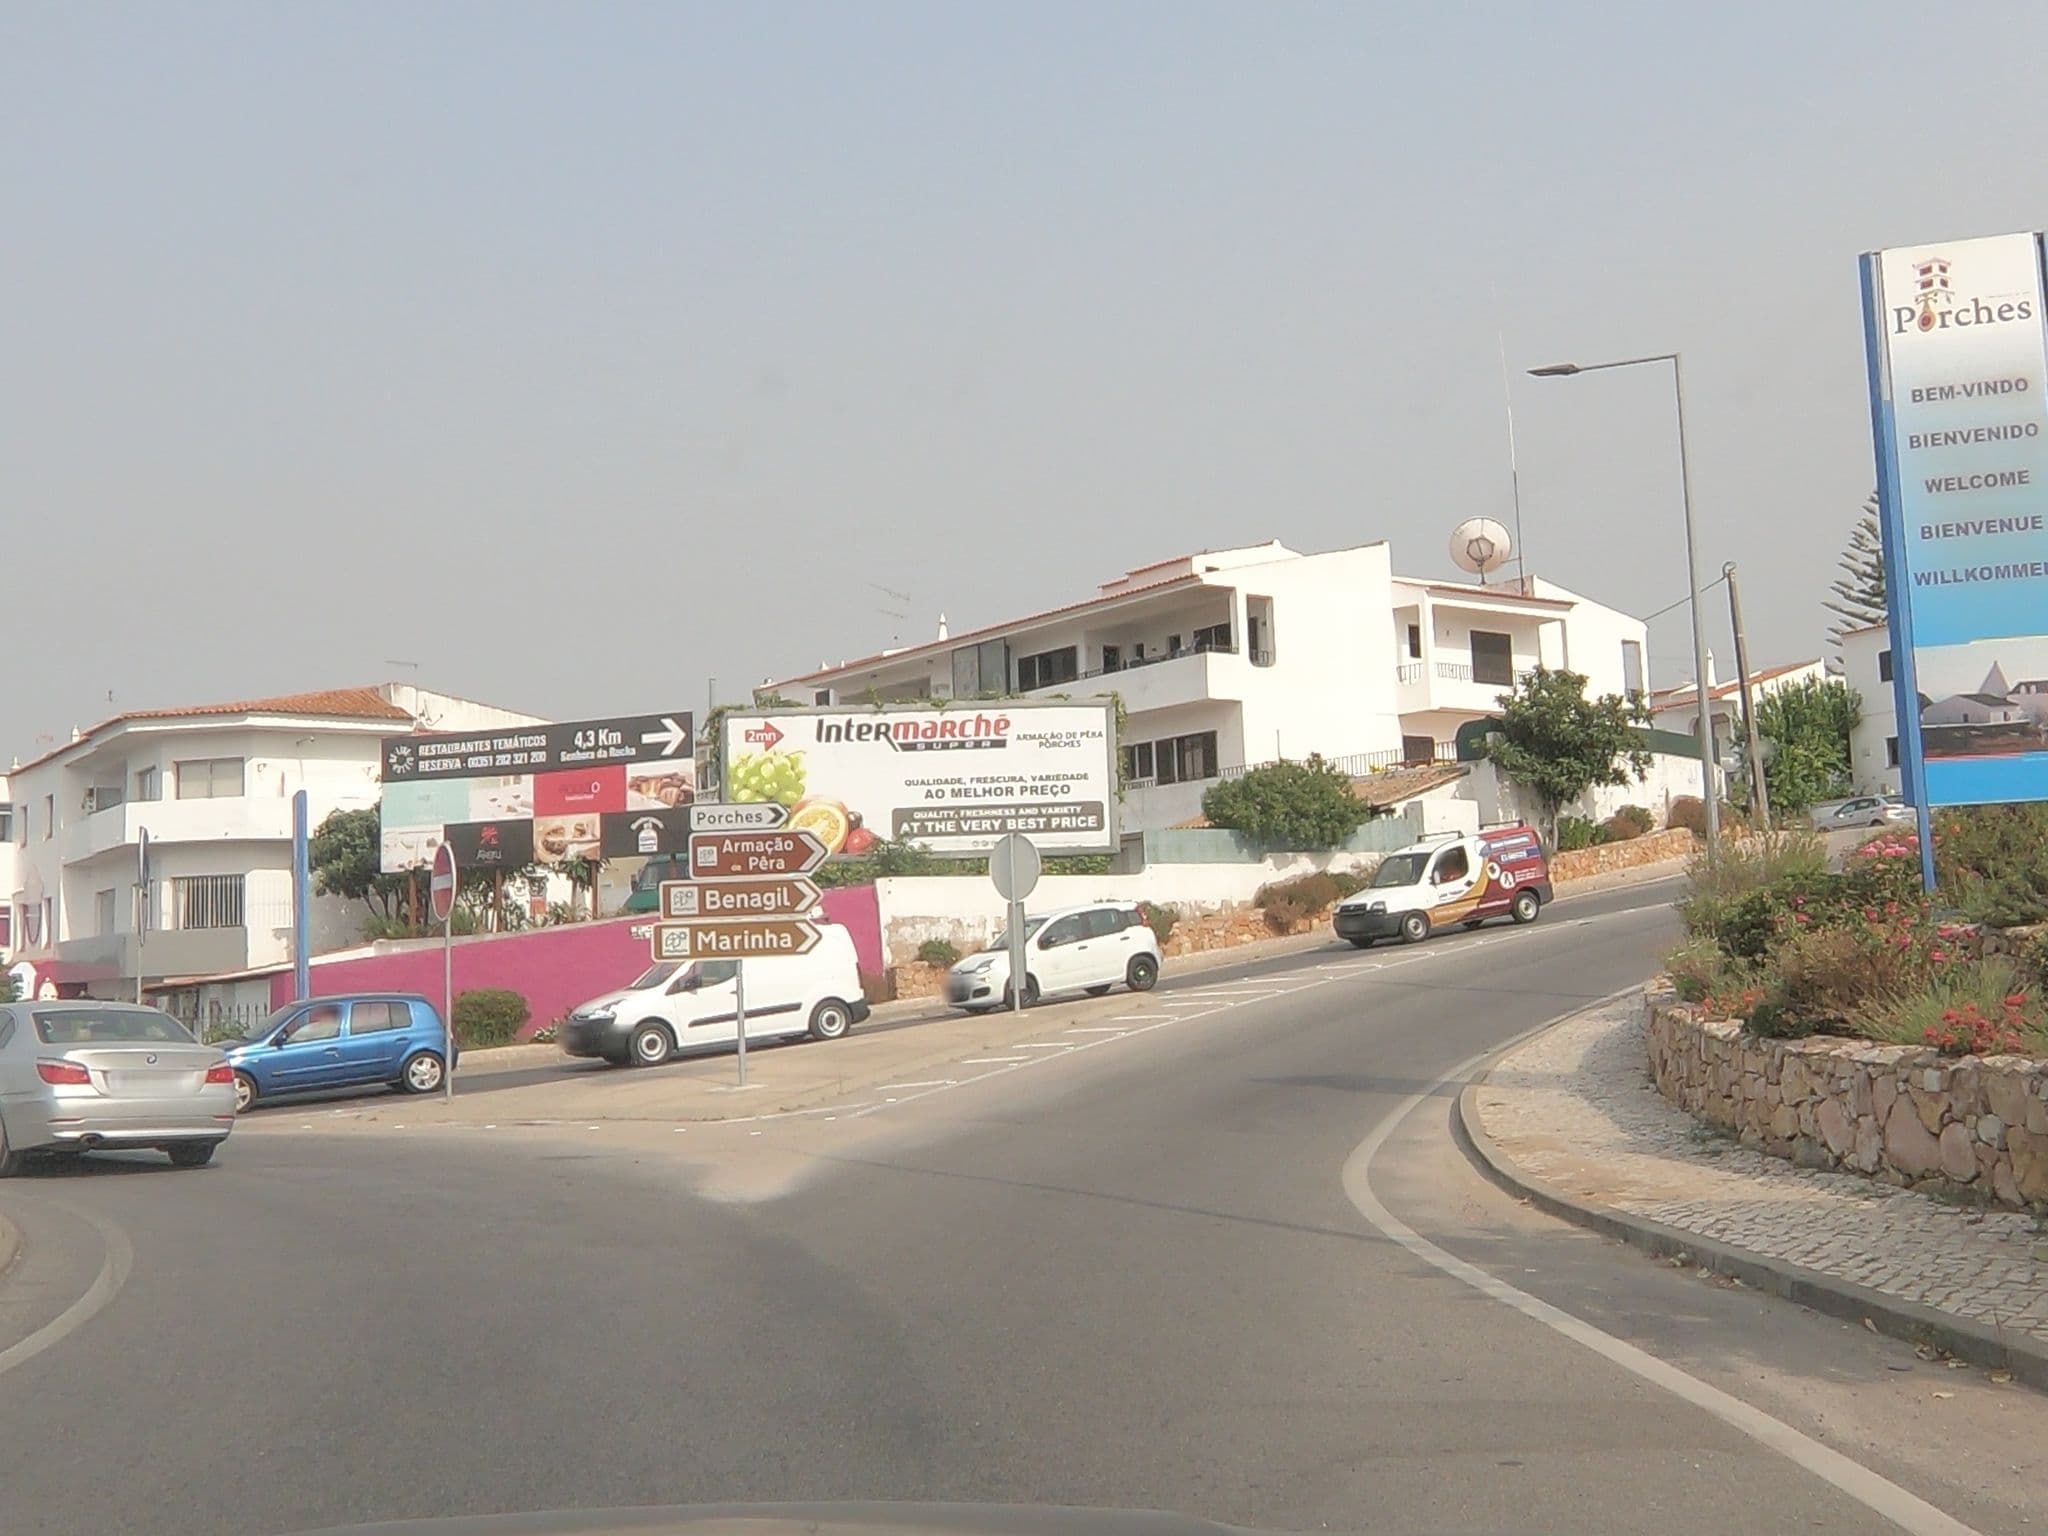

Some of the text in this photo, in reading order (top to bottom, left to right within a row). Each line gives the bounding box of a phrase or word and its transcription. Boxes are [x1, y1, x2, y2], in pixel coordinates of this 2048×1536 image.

[1893, 298, 2032, 334] Porches
[1911, 377, 2030, 404] BEM-VINDO
[1908, 422, 2040, 450] BIENVENIDO
[1924, 470, 2031, 494] WELCOME
[1919, 515, 2044, 541] BIENVENUE
[418, 734, 547, 757] RESTAURANTES TEMÁTICOS
[574, 728, 622, 750] 4,3 Km
[748, 731, 778, 742] 2mn
[916, 739, 992, 751] SUPER
[418, 757, 462, 773] RESERVA
[1030, 772, 1090, 782] VARIEDADE
[924, 784, 1071, 800] AO MELHOR PREÇO
[696, 811, 763, 825] Porches
[899, 815, 1099, 835] AT THE VERY BEST PRICE
[722, 838, 794, 855] Armação
[748, 855, 786, 871] Pêra
[704, 886, 791, 911] Benagil
[696, 930, 793, 952] Marinha
